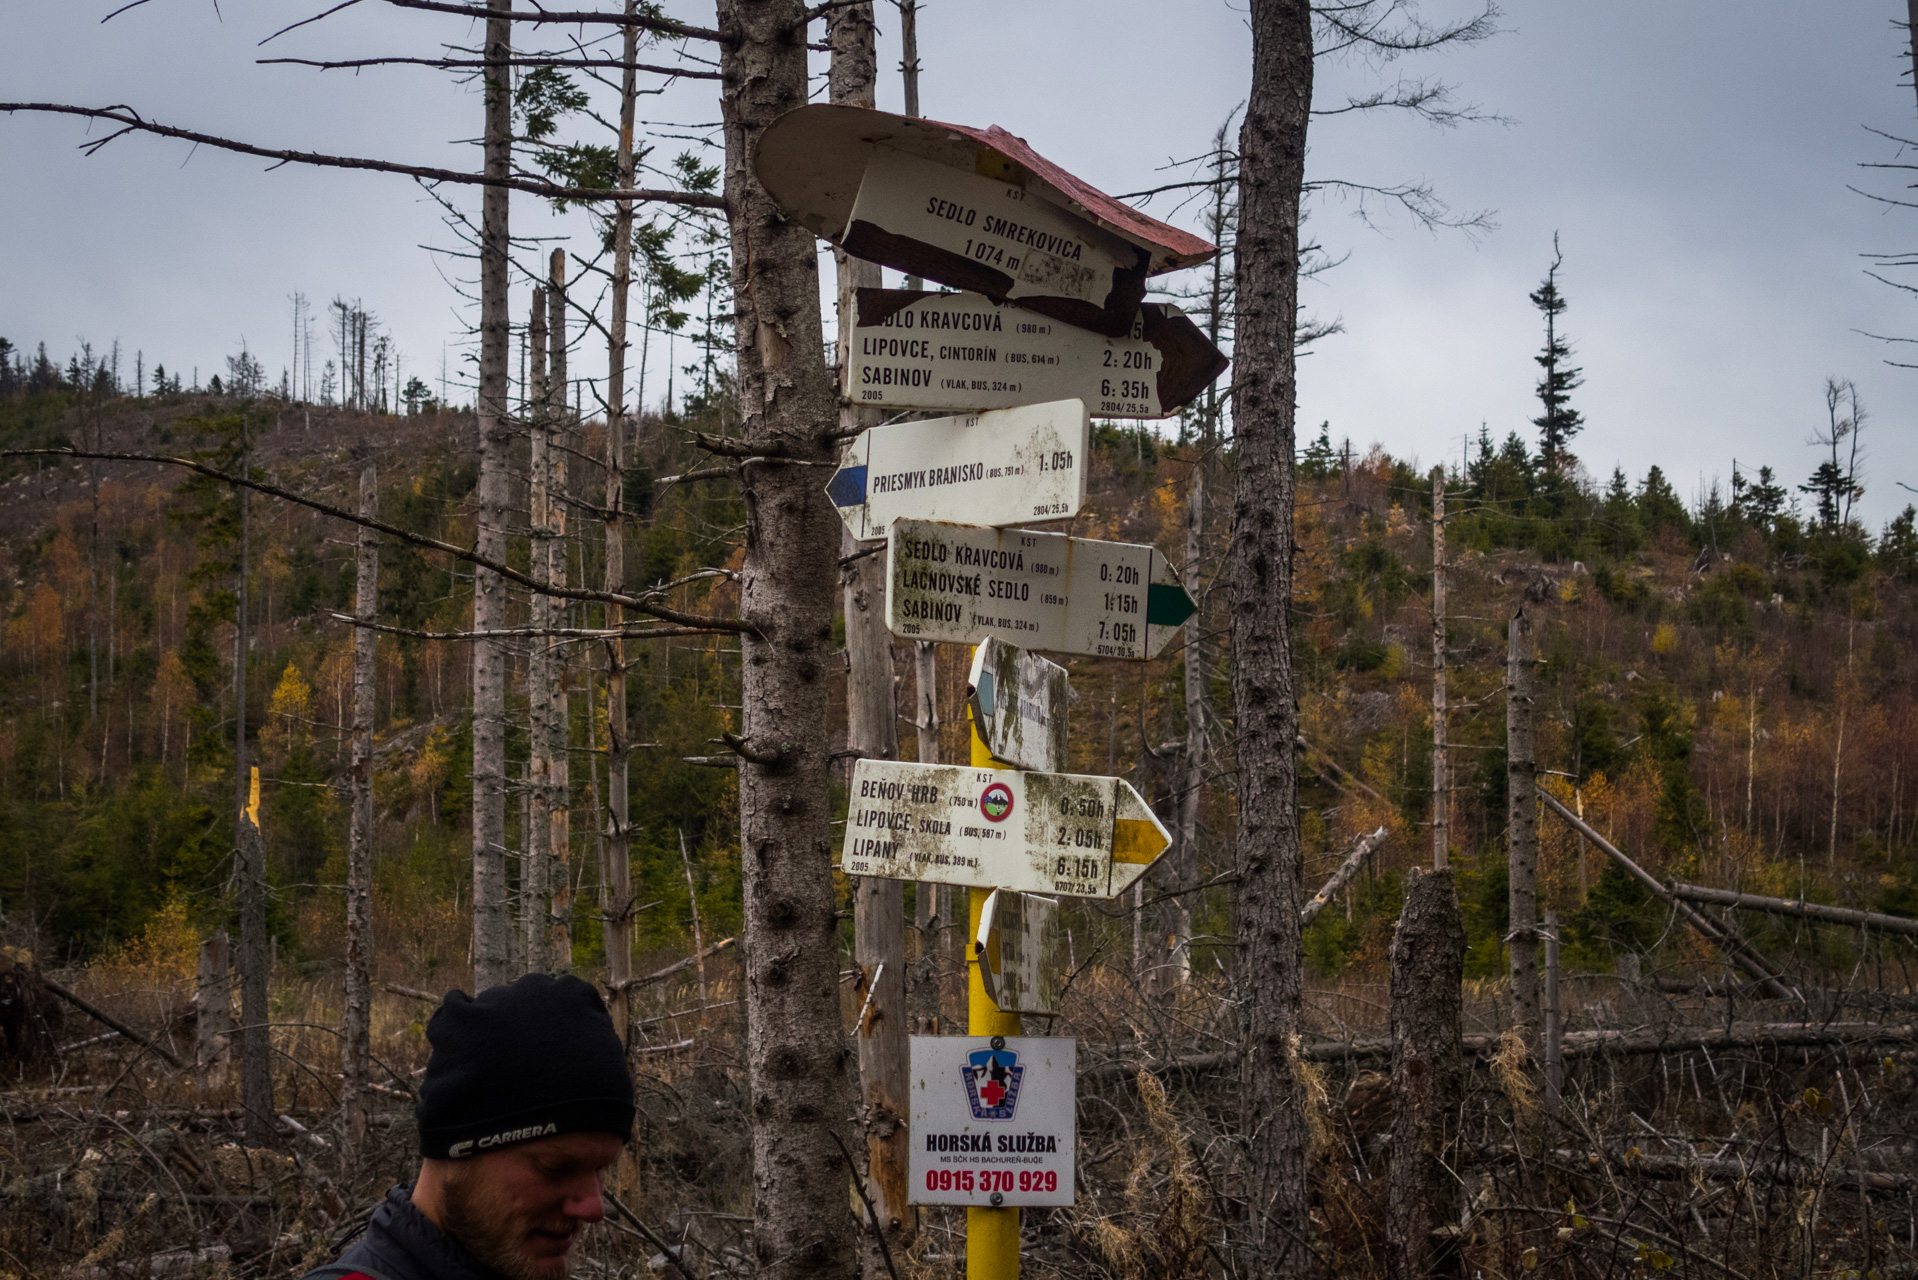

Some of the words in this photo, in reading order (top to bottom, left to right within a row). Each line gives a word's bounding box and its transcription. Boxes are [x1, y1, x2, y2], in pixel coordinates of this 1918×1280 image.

[926, 197, 976, 227] SEDLO
[983, 215, 1082, 261] SMREKOVICA
[1006, 256, 1020, 271] m
[920, 310, 1002, 332] KRAVCOVÁ
[863, 337, 934, 362] LIPOVCE,
[939, 345, 997, 362] CINTORÍN
[862, 366, 932, 387] SABINOV
[971, 380, 990, 392] BUS,
[992, 381, 1007, 392] 324
[862, 390, 883, 400] 2005
[965, 417, 979, 428] KST
[873, 469, 927, 494] PRIESMYK
[928, 462, 984, 487] BRANISKO
[1004, 465, 1015, 477] 751
[871, 526, 885, 536] 2005
[1021, 536, 1037, 548] KST
[905, 540, 947, 563] SEDLO
[955, 545, 1024, 572] KRAVCOVÁ
[988, 579, 1029, 602] SEDLO
[903, 599, 962, 623] SABINOV
[1014, 618, 1028, 630] 324
[903, 623, 920, 635] 2005
[976, 773, 993, 783] KST
[860, 777, 905, 801] BEŇOV
[911, 785, 939, 804] HRB
[856, 809, 915, 834] LIPOVCE,
[919, 816, 951, 835] ŠKOLA
[981, 828, 995, 839] 587
[853, 838, 901, 860] LIPANY
[952, 855, 966, 867] 389
[851, 861, 869, 872] 2005
[478, 1122, 557, 1148] CARRERA
[926, 1132, 992, 1153] HORSKÁ
[997, 1132, 1057, 1153] SLUŽBA
[926, 1169, 975, 1192] 0915
[979, 1170, 1014, 1192] 370
[1019, 1170, 1058, 1192] 929
